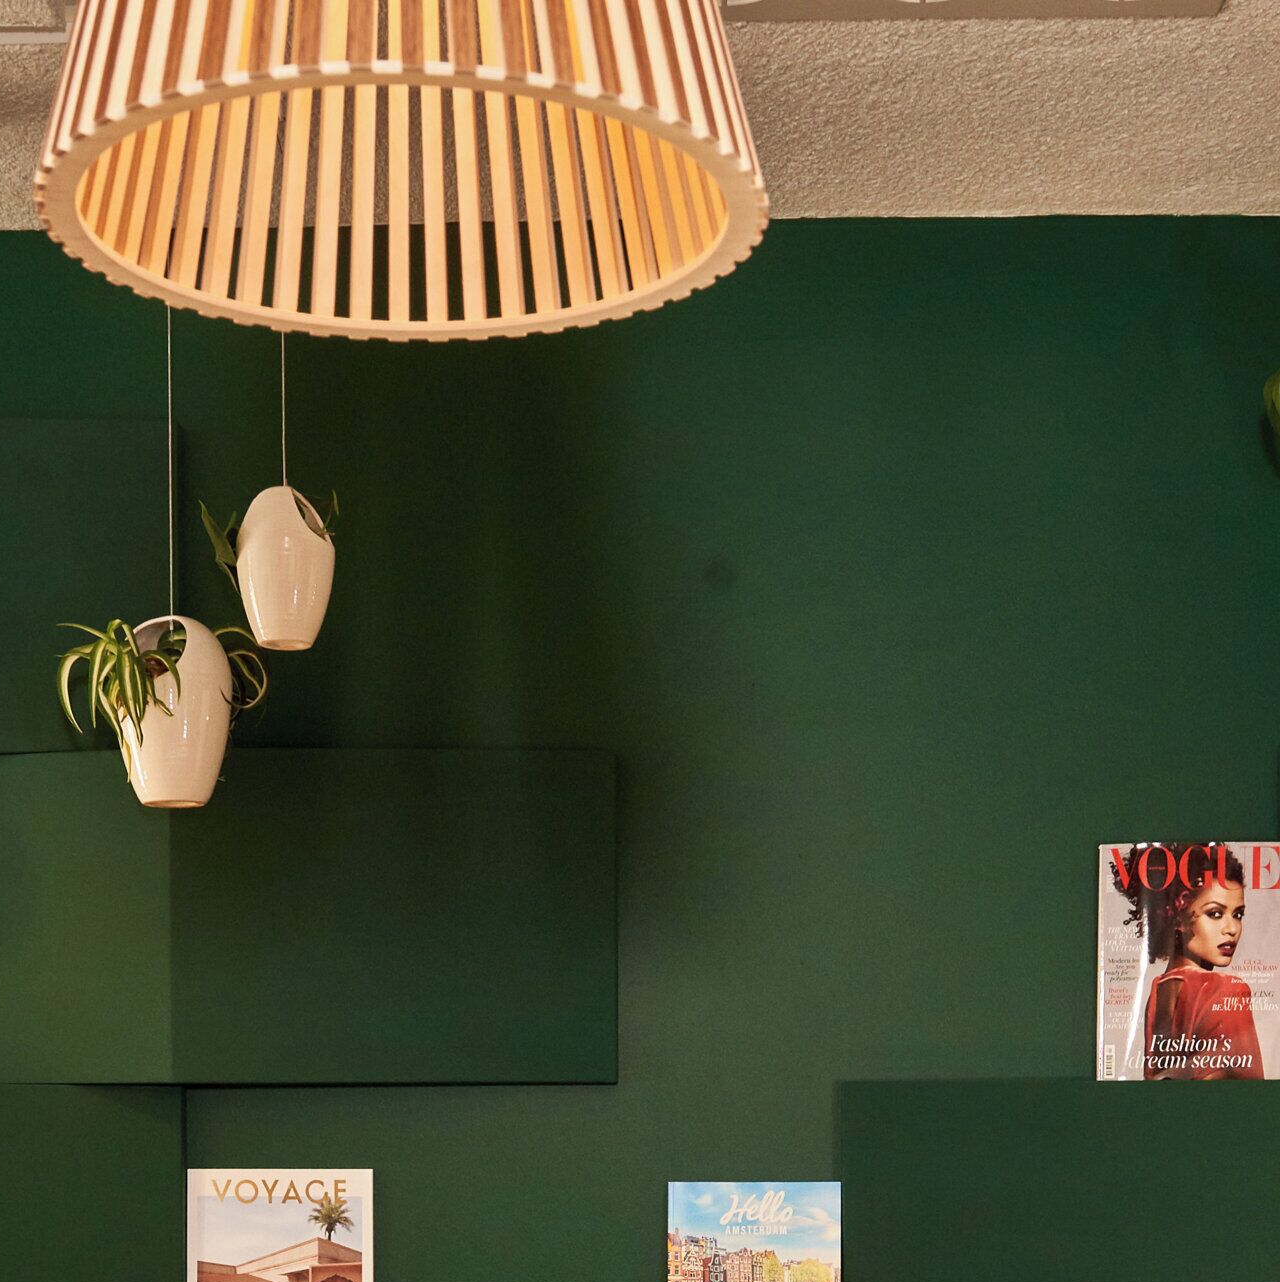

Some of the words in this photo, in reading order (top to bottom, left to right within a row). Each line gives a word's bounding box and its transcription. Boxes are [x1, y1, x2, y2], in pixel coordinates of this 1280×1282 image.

[1110, 845, 1280, 891] VOGUE
[1212, 1003, 1243, 1012] BEAUTY
[1150, 1033, 1232, 1053] Fashion's
[1128, 1051, 1187, 1069] dream
[1191, 1054, 1254, 1069] season
[211, 1178, 348, 1205] VOYAGE
[719, 1190, 794, 1225] Hello
[725, 1225, 788, 1236] AMSTERDAM
